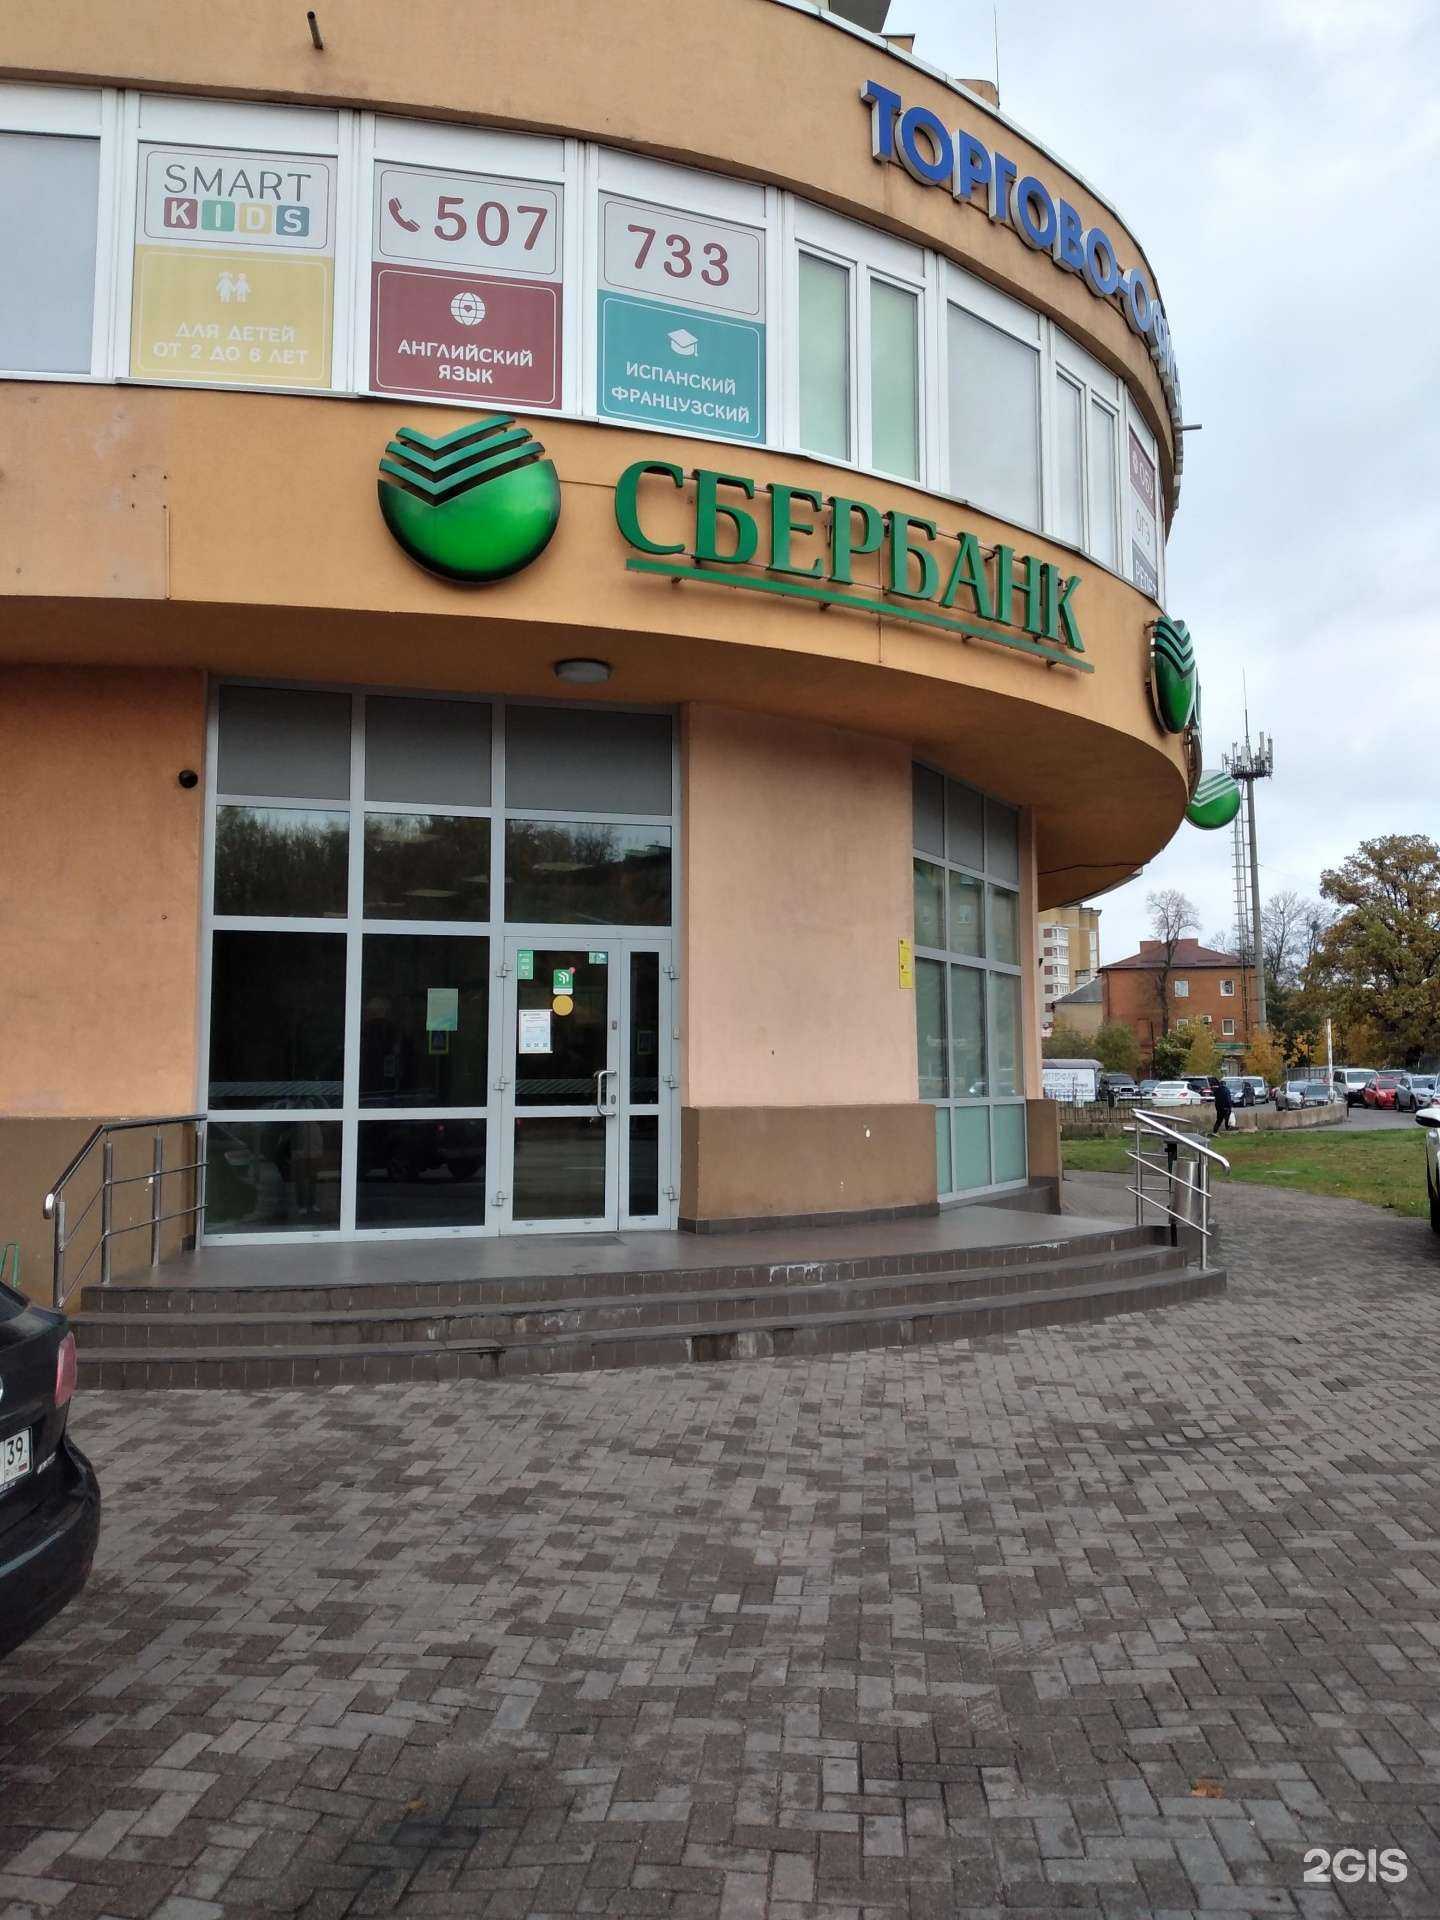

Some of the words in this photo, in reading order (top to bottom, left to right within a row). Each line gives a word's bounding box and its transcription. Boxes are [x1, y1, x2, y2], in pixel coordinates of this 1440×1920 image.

[164, 164, 312, 202] SMART
[168, 199, 305, 234] KIDS
[434, 195, 549, 251] 507
[627, 223, 730, 287] 733
[176, 321, 219, 339] ДЛЯ
[228, 323, 297, 343] ДЕТЕЙ
[152, 341, 182, 358] ОТ
[191, 344, 203, 360] 2
[209, 345, 241, 361] ДО
[250, 347, 262, 363] 6
[269, 348, 309, 365] ЛЕТ
[397, 338, 534, 368] АНГЛИЙСКИЙ
[438, 364, 495, 385] ЯЗЫК
[625, 360, 737, 396] ИСПАНСКИЙ
[610, 385, 751, 425] ФРАНЦУЗСКИЙ
[614, 459, 1086, 654] СБЕРБАНК
[7, 1436, 24, 1466] 39
